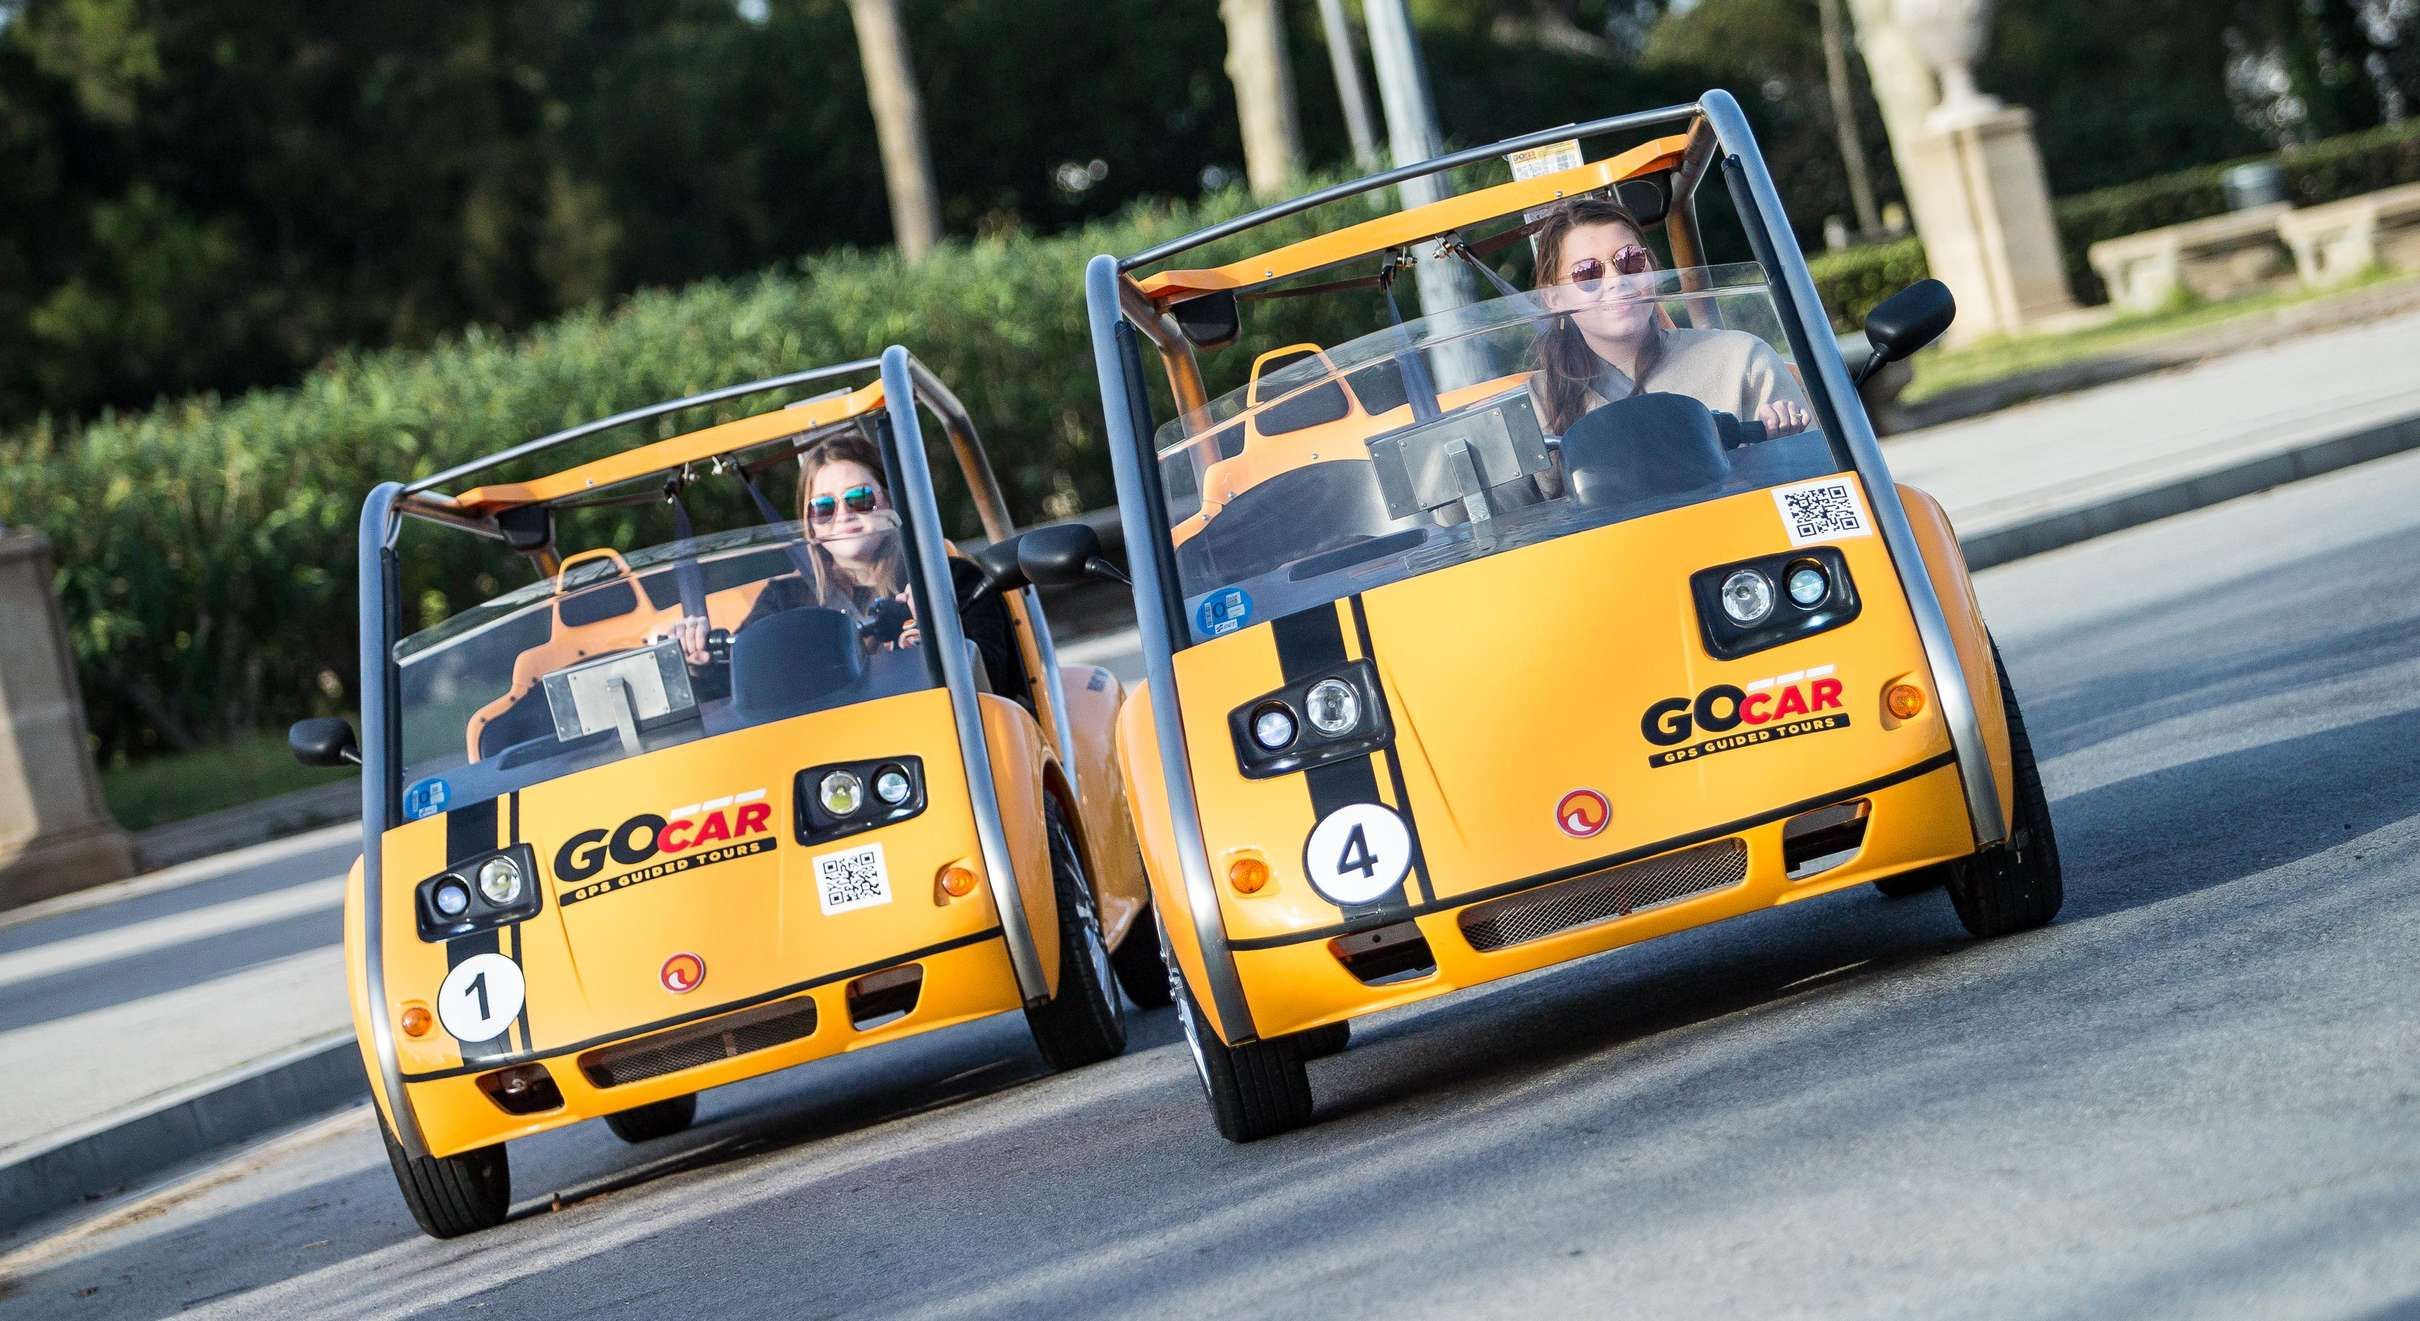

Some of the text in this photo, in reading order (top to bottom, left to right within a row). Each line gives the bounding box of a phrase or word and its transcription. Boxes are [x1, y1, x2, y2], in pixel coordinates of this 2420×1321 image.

[1641, 678, 1843, 746] GOCAR
[1664, 717, 1836, 763] GPS GUIDED TOURS
[553, 802, 772, 882] GOCAR
[1336, 822, 1379, 879] 4
[575, 842, 761, 900] GPS GUIDED TOURS
[465, 971, 491, 1021] 1
